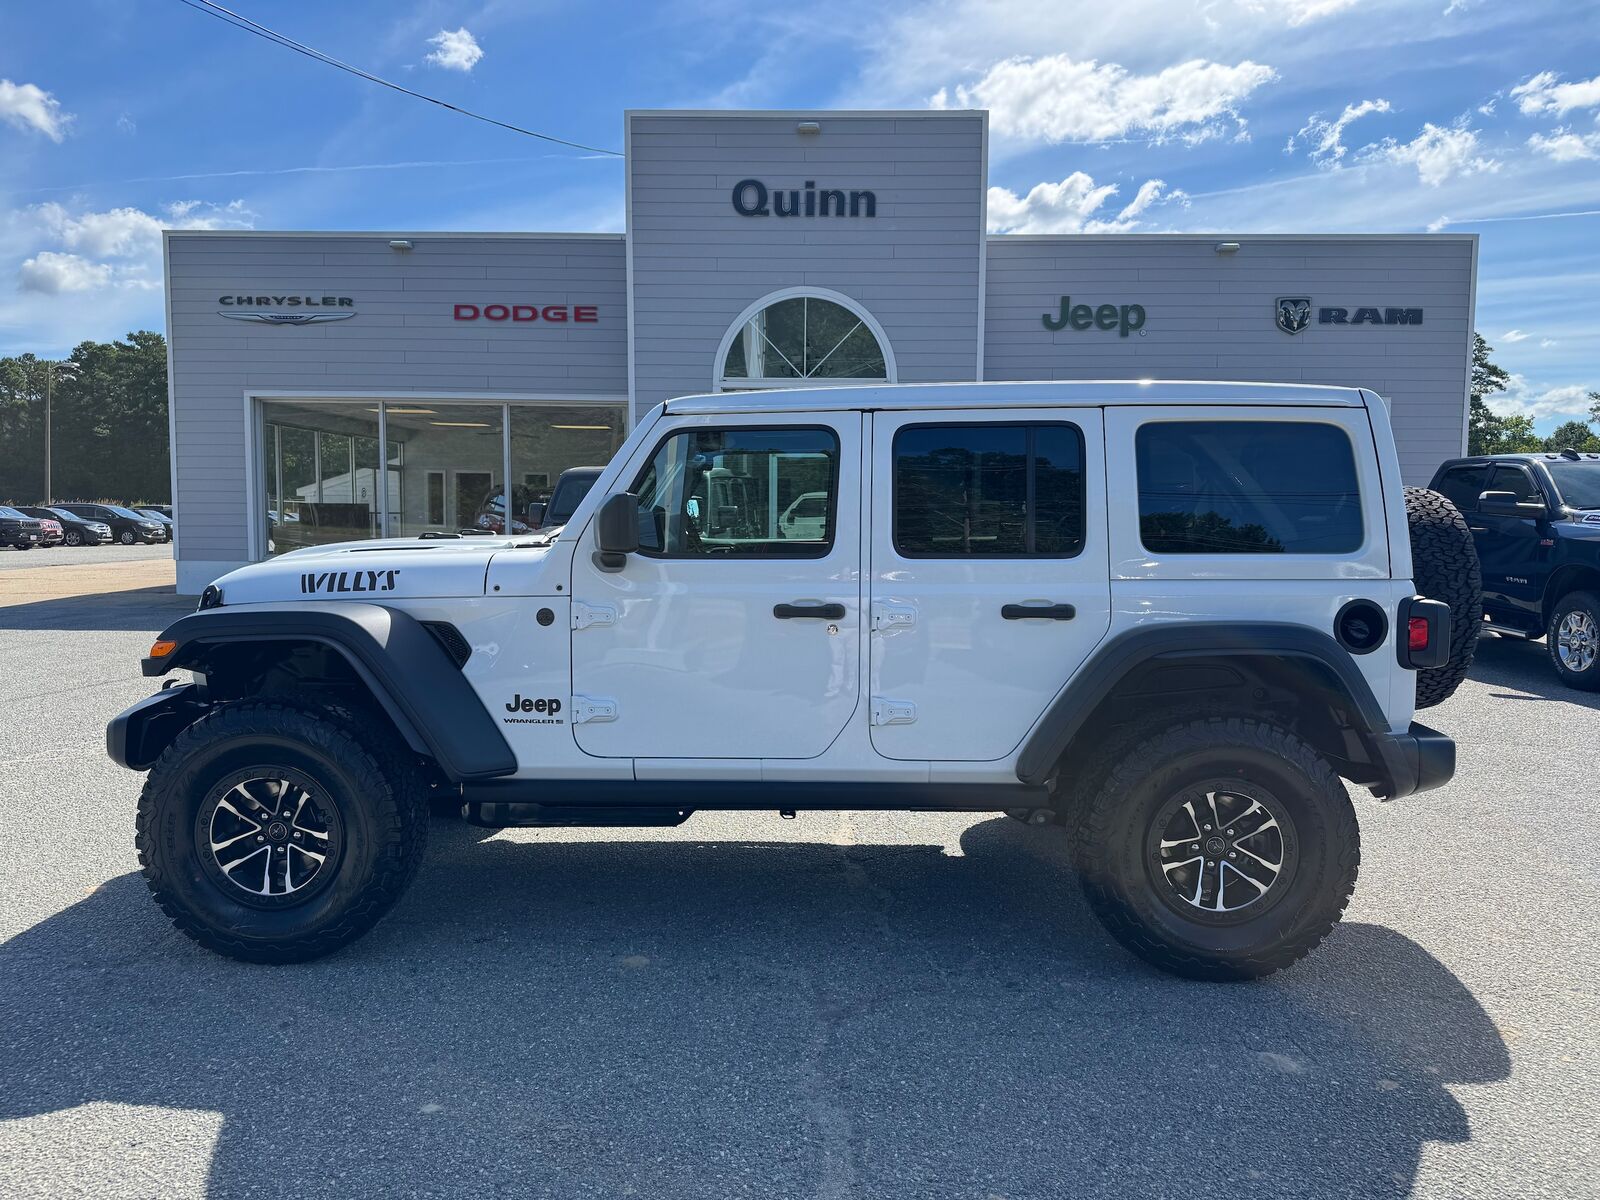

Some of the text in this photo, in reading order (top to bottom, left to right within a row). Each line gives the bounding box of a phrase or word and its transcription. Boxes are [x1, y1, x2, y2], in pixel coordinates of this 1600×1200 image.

[732, 179, 877, 218] Quinn
[219, 296, 354, 307] CHRYSLER
[453, 304, 599, 323] DODGE
[1042, 295, 1146, 337] Jeep
[1319, 307, 1423, 325] RAM
[301, 570, 401, 593] WILLYS
[505, 694, 562, 716] Jeep
